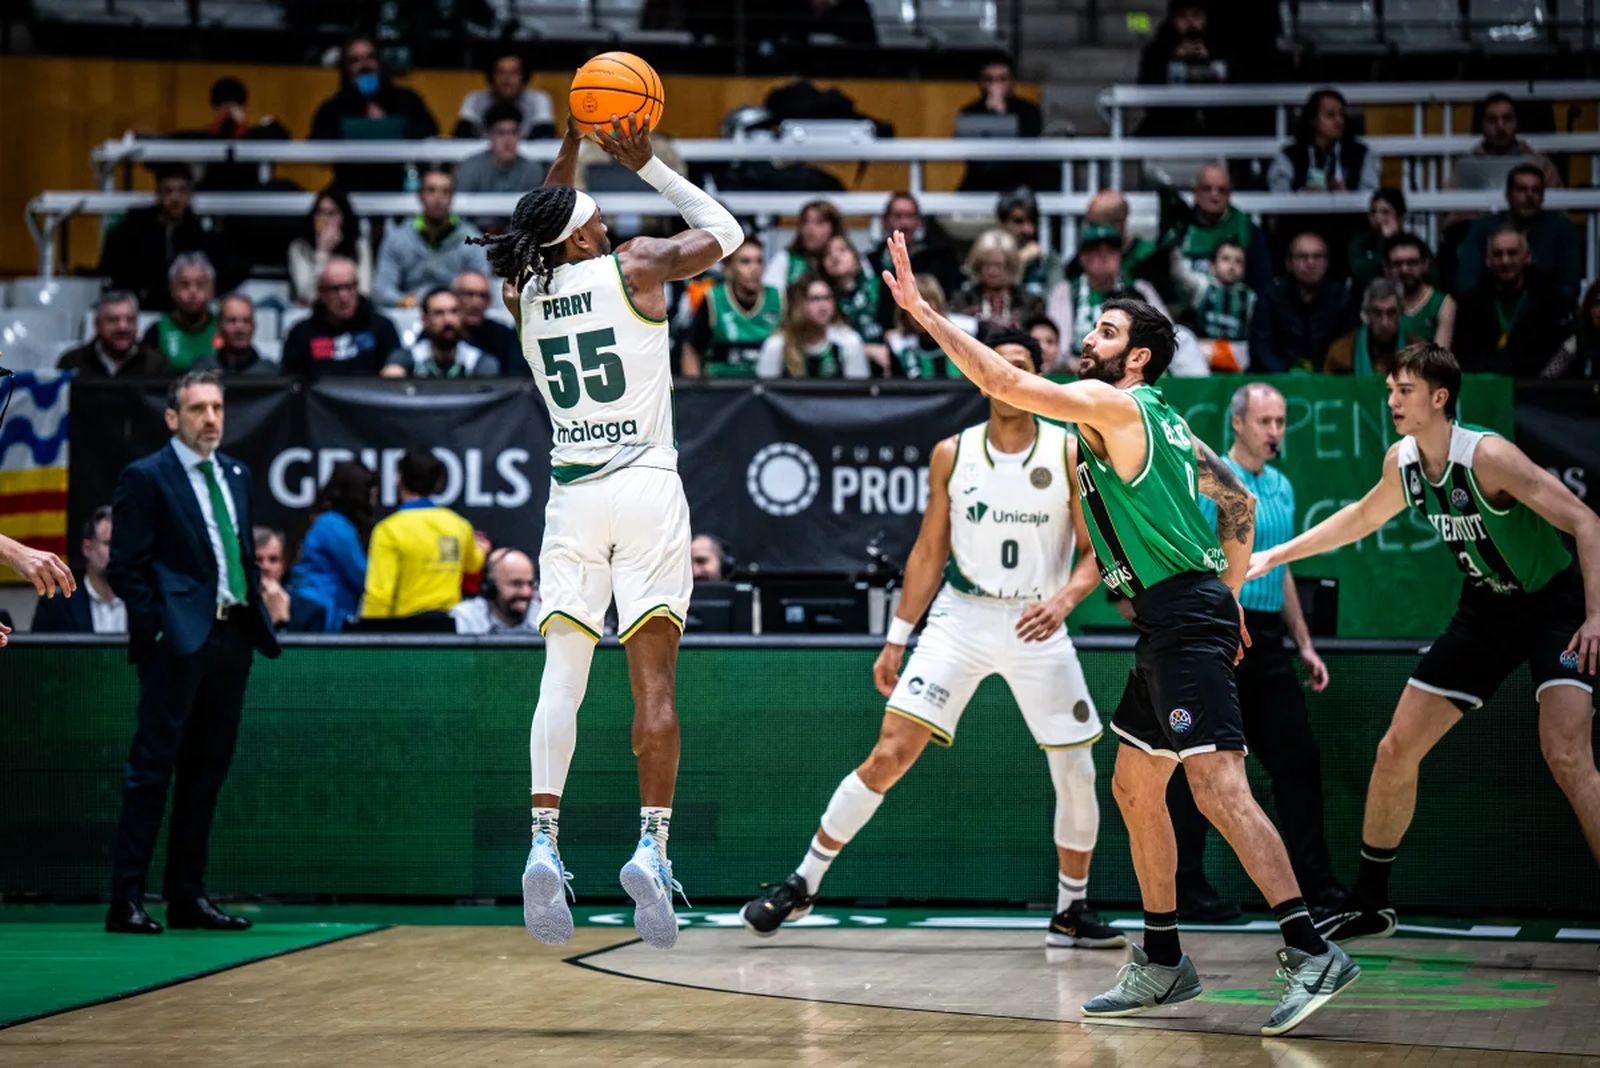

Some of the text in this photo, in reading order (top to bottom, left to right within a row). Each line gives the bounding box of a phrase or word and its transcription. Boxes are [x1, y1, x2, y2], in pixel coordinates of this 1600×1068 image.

[543, 291, 592, 320] PERRY
[538, 326, 626, 409] 55
[557, 419, 638, 443] màlaga
[992, 510, 1050, 527] Unicaja
[1001, 539, 1019, 569] 0
